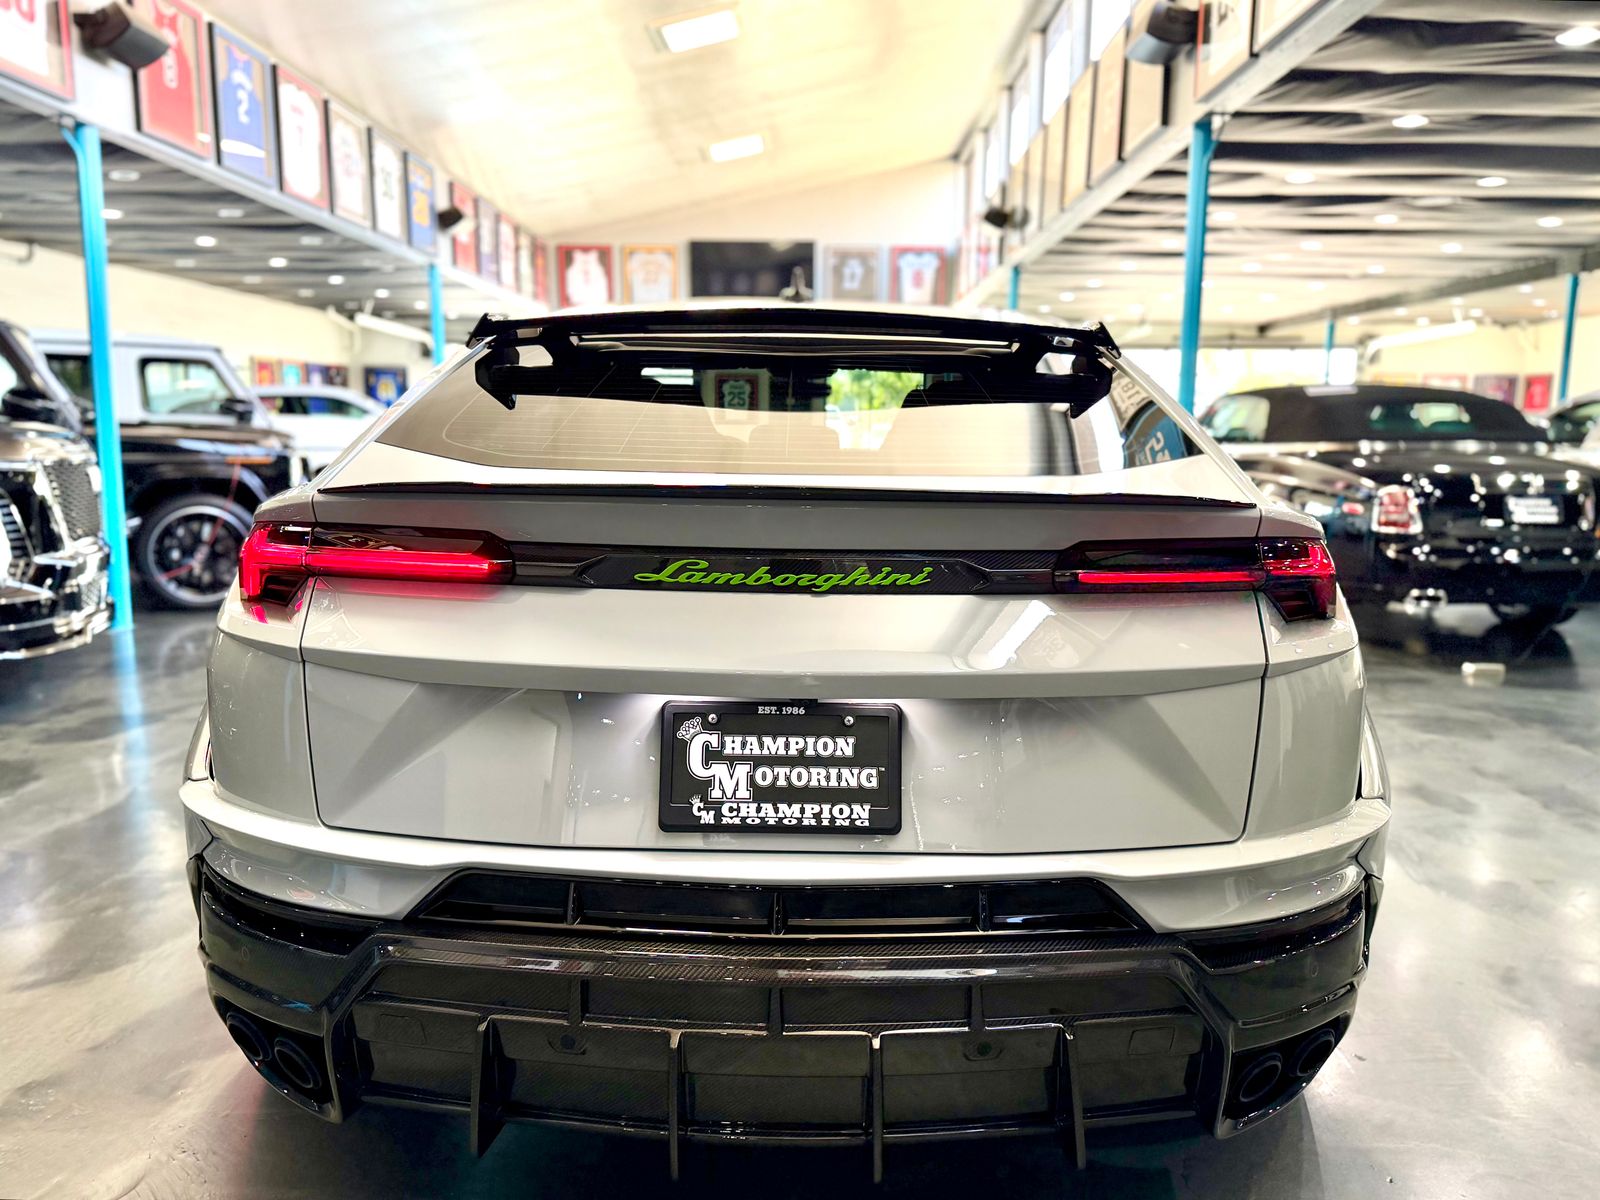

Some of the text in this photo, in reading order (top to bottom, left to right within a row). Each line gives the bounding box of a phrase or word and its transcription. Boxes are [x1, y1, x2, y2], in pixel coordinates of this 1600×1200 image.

[727, 391, 746, 407] 25
[633, 559, 934, 592] Lamborghini
[757, 706, 806, 715] EST. 1986
[687, 731, 856, 780] CHAMPION
[708, 761, 879, 801] MOTORING
[721, 803, 871, 820] CHAMPION
[721, 816, 870, 827] MOTORING
